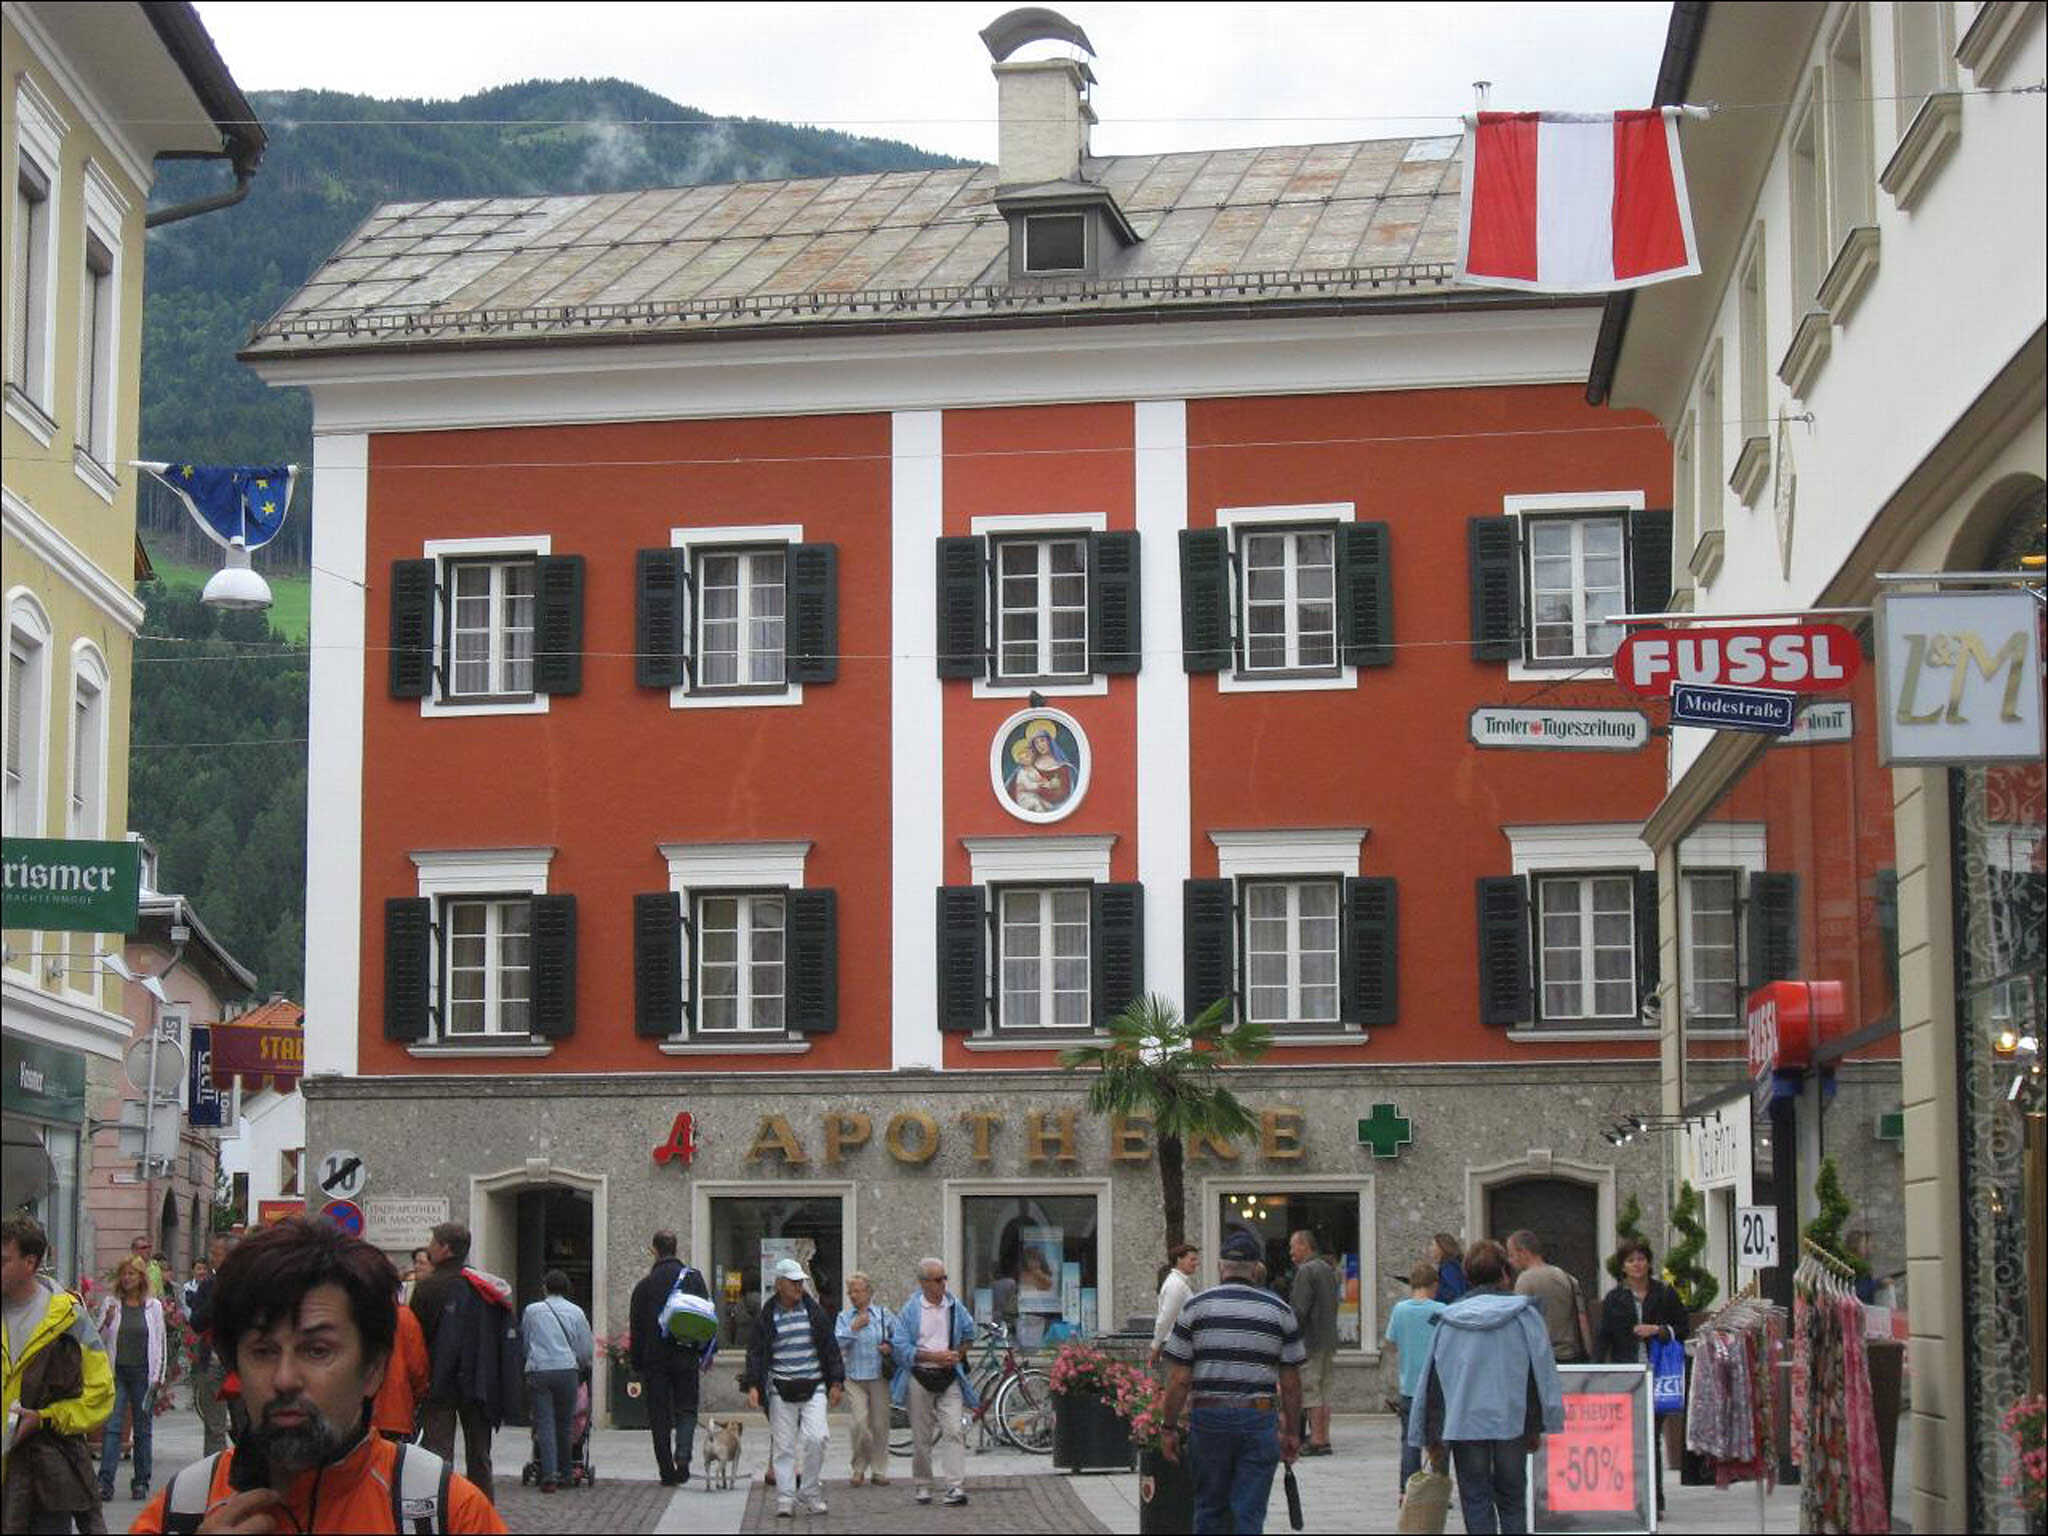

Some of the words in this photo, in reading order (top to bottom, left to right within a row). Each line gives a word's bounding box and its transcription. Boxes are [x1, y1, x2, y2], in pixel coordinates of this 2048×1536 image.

[1632, 634, 1844, 686] FUSSL
[1897, 631, 2029, 725] L&M
[1685, 695, 1783, 719] Modestraße
[1484, 716, 1530, 735] Tiroler
[1541, 717, 1636, 740] Tageszeitung
[2, 855, 116, 892] rismer
[326, 1157, 357, 1190] 10
[1583, 1403, 1624, 1421] HEUTE
[1558, 1445, 1625, 1492] -50%
